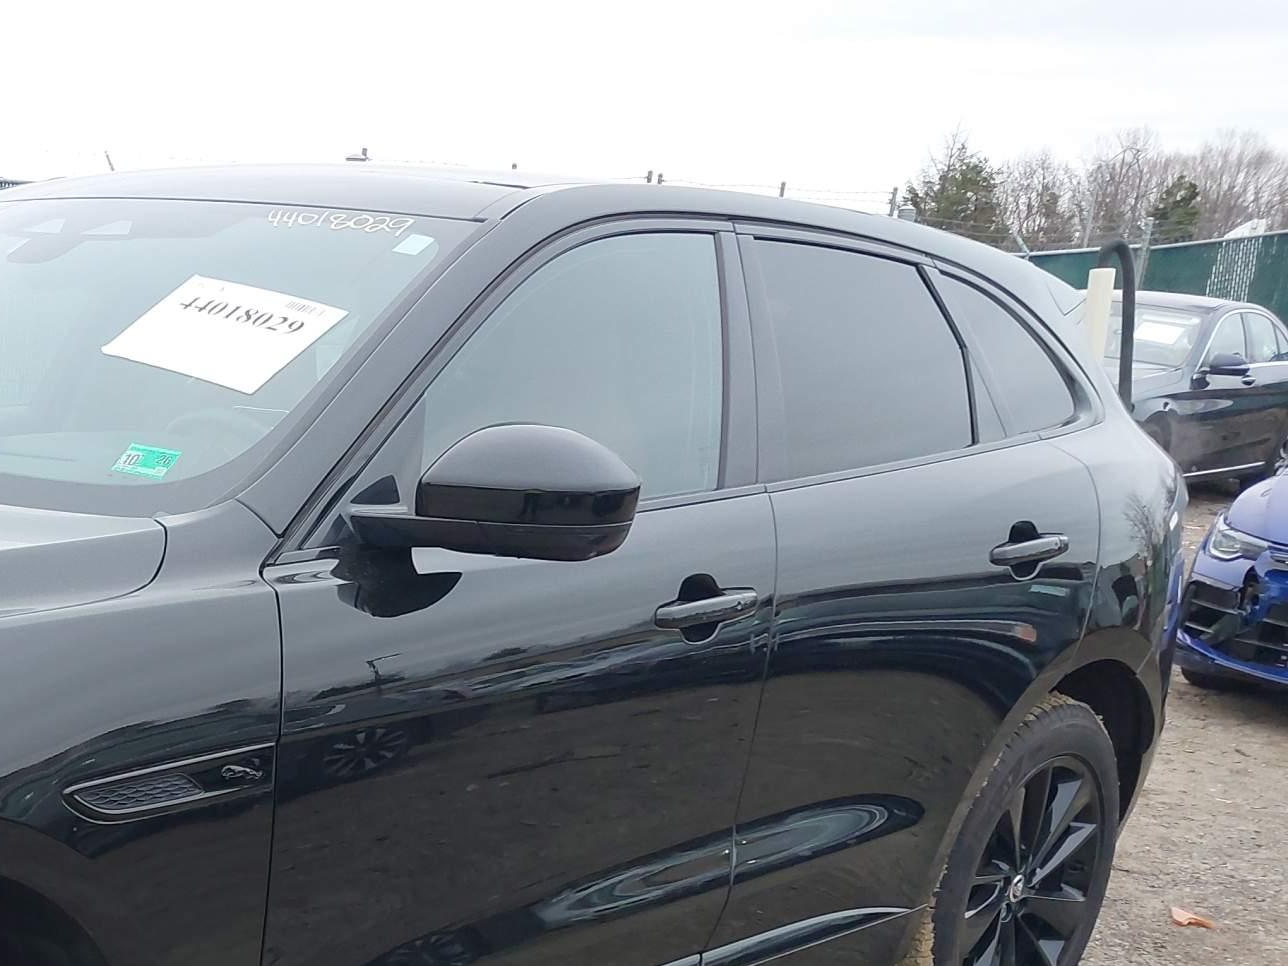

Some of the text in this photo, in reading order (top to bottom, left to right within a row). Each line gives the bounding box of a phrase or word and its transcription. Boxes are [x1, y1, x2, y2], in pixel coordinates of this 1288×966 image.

[267, 208, 416, 237] 44018029
[179, 296, 305, 335] 44018029
[122, 453, 140, 466] 10
